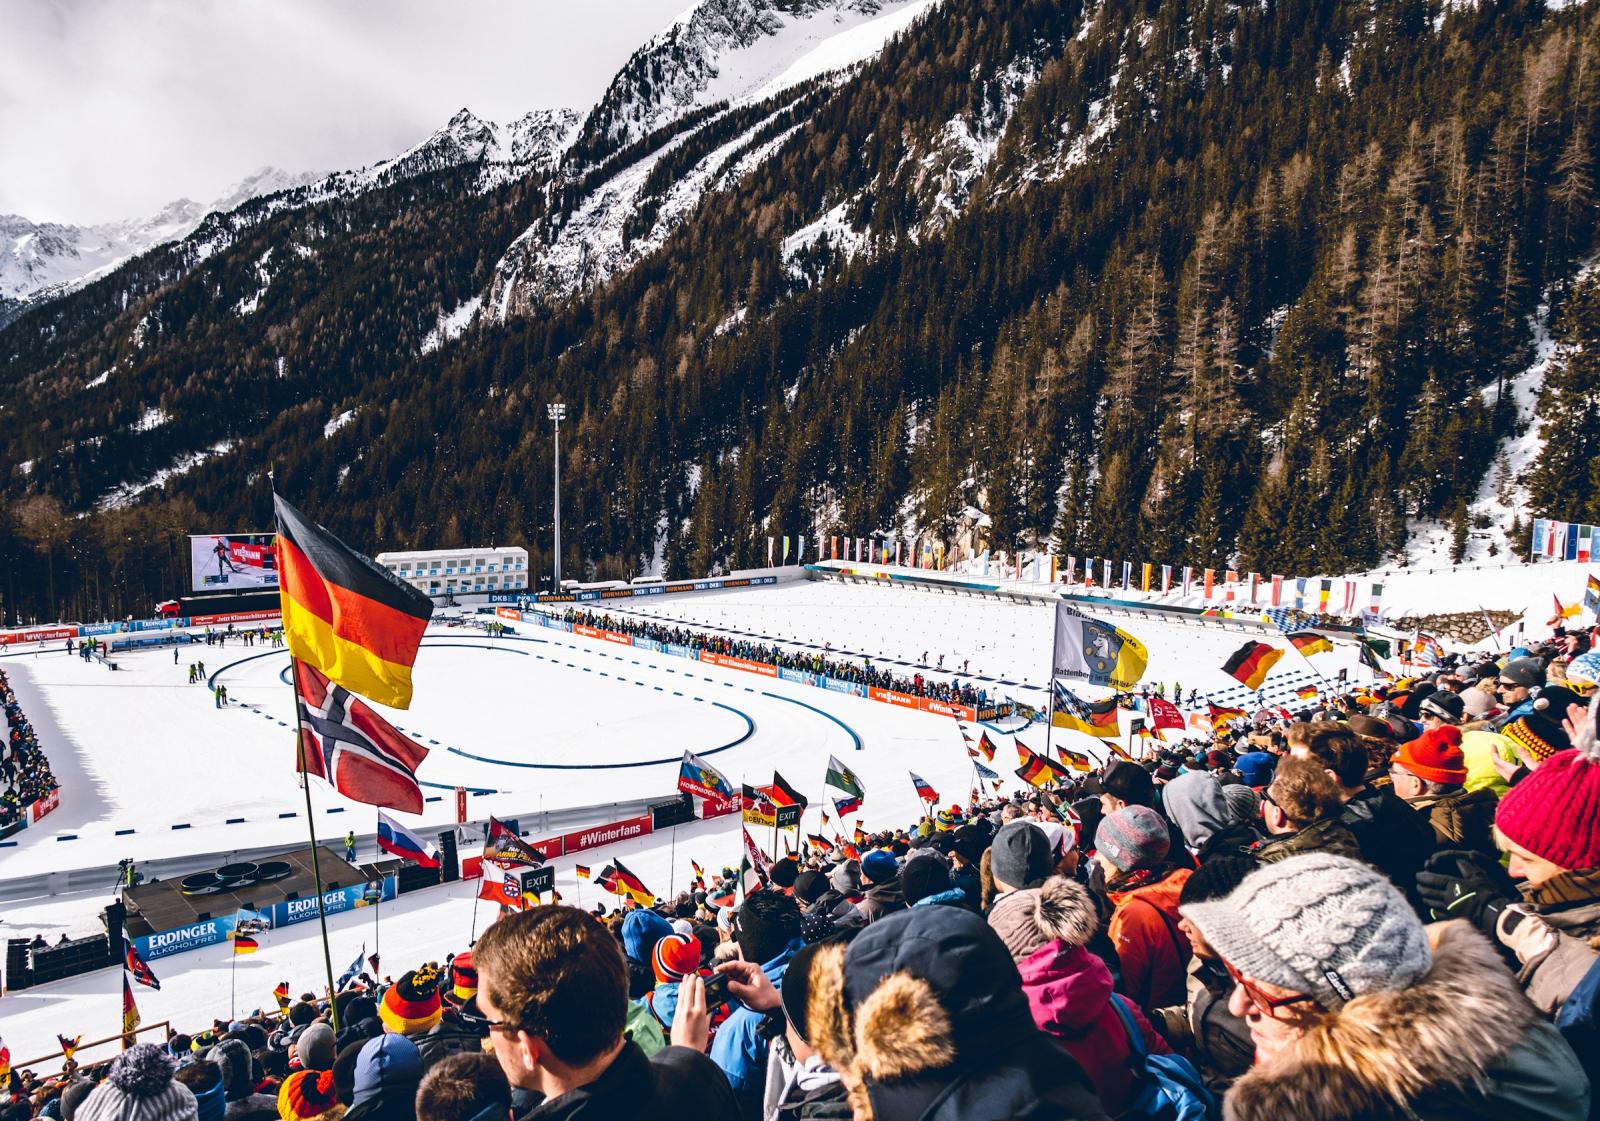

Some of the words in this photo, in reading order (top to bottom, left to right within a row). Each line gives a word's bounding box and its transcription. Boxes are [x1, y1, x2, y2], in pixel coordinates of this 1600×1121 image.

[779, 811, 796, 821] EXIT
[580, 824, 641, 847] #Winterfans
[526, 875, 548, 888] EXIT
[288, 903, 346, 922] ALKOHOLFREI
[148, 922, 217, 949] ERDINGER
[149, 935, 216, 957] ALKOHOLFREI
